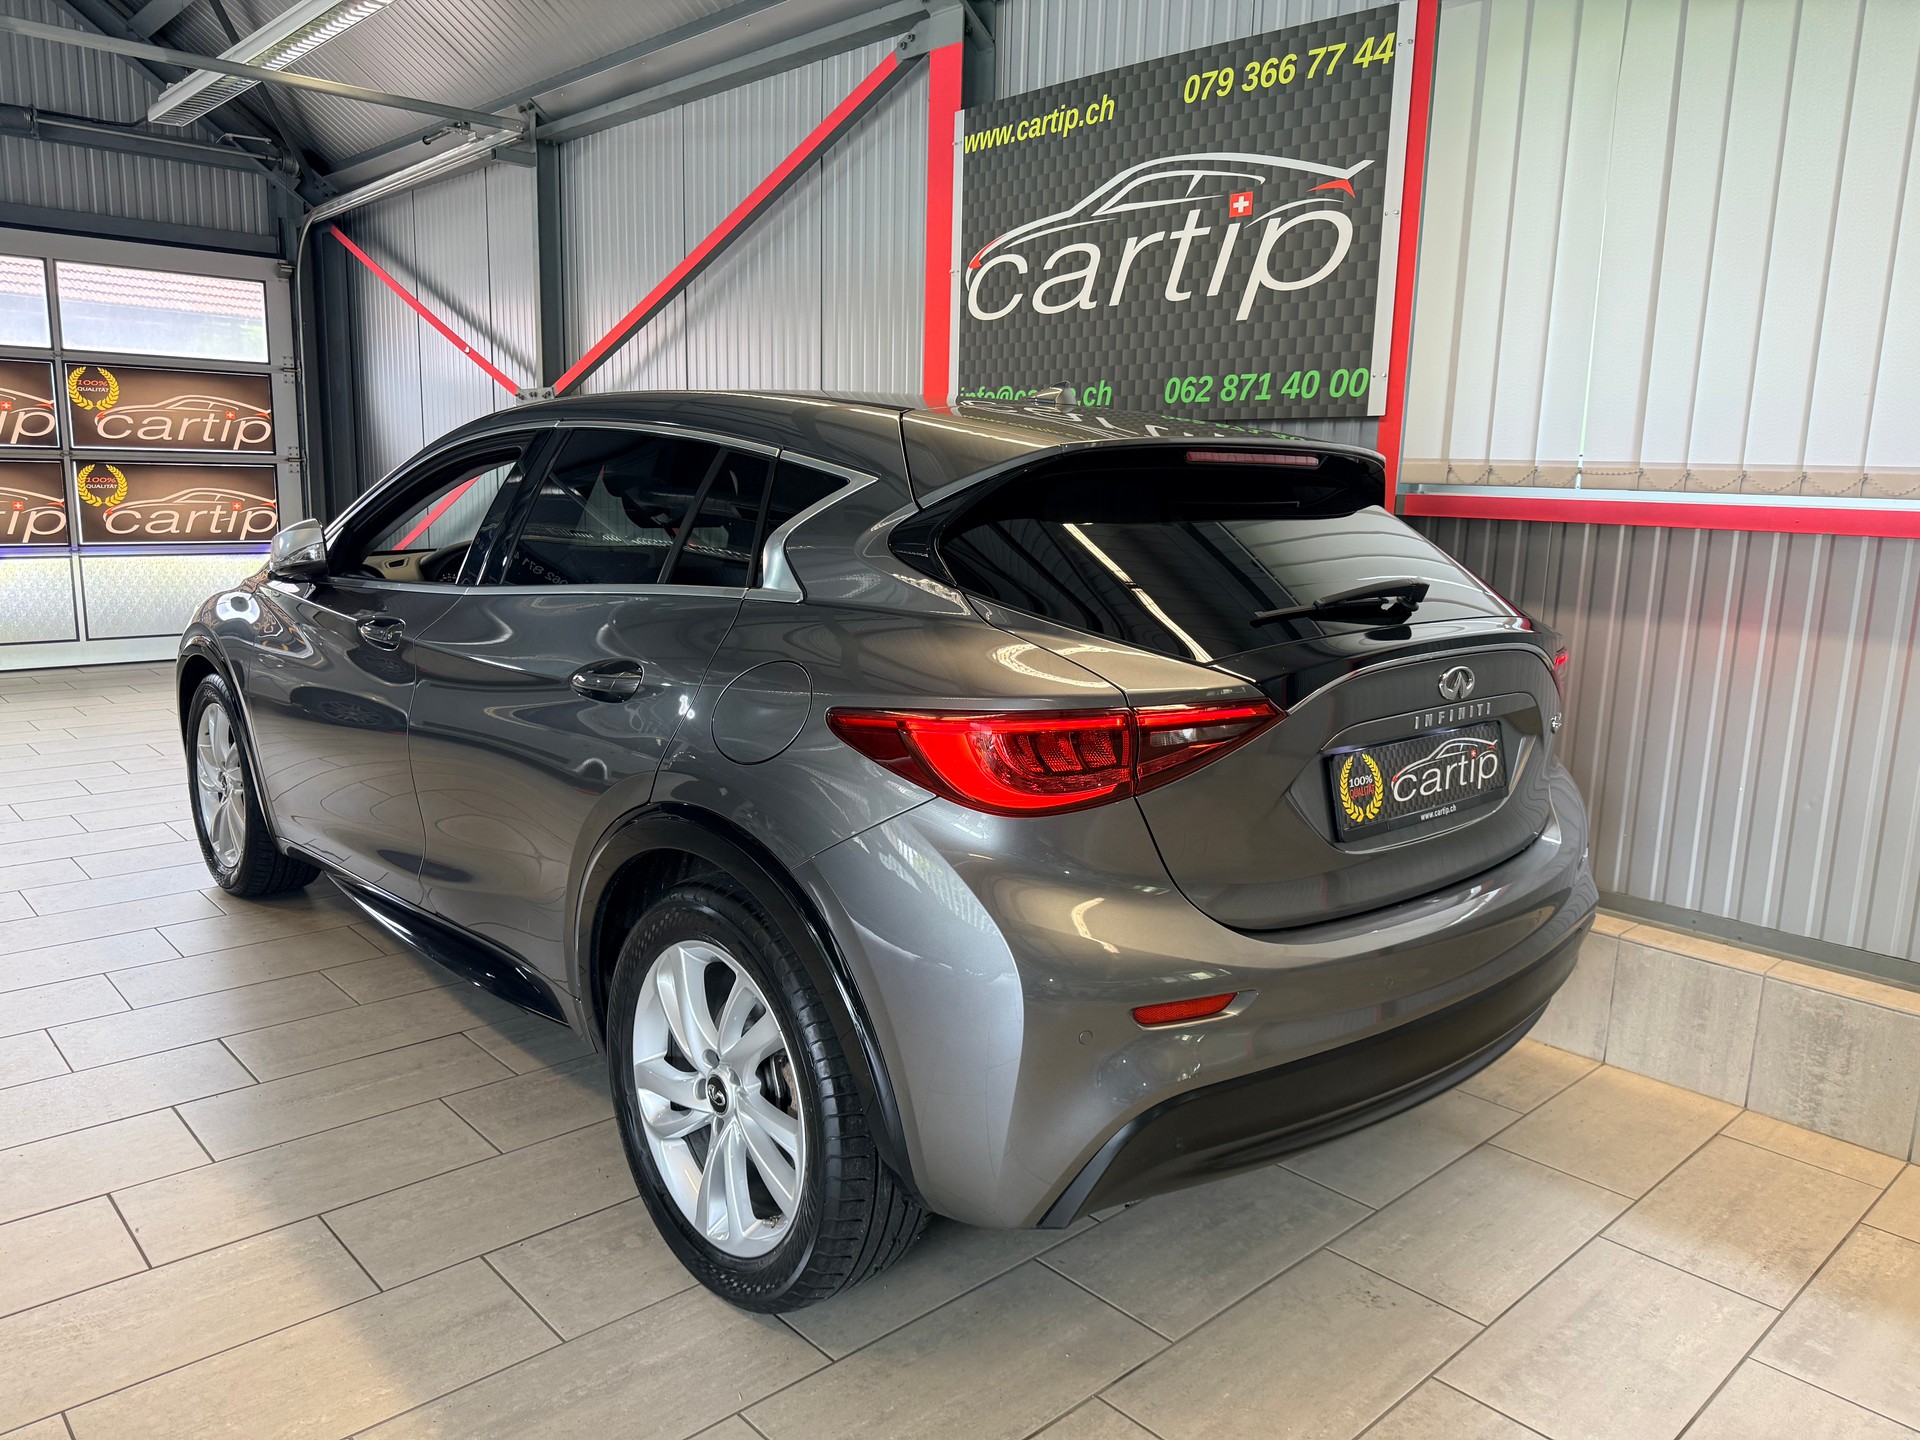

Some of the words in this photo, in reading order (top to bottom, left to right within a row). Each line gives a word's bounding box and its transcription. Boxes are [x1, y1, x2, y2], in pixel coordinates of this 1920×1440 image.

[1183, 67, 1235, 104] 079
[1241, 53, 1298, 92] 366
[1306, 42, 1347, 80] 77
[1352, 32, 1396, 69] 44
[964, 93, 1115, 154] www.cartip.ch
[967, 192, 1355, 321] cartip
[77, 379, 108, 387] 100%
[1164, 375, 1213, 404] 062
[1220, 372, 1272, 402] 871
[1281, 370, 1321, 400] 40
[1329, 367, 1370, 398] 00
[96, 411, 272, 450] cartip
[105, 502, 278, 541] cartip
[1414, 702, 1491, 730] INFINITI
[1348, 774, 1373, 788] 100%
[1392, 750, 1498, 802] cartip
[1420, 803, 1457, 821] www.cartip.ch
